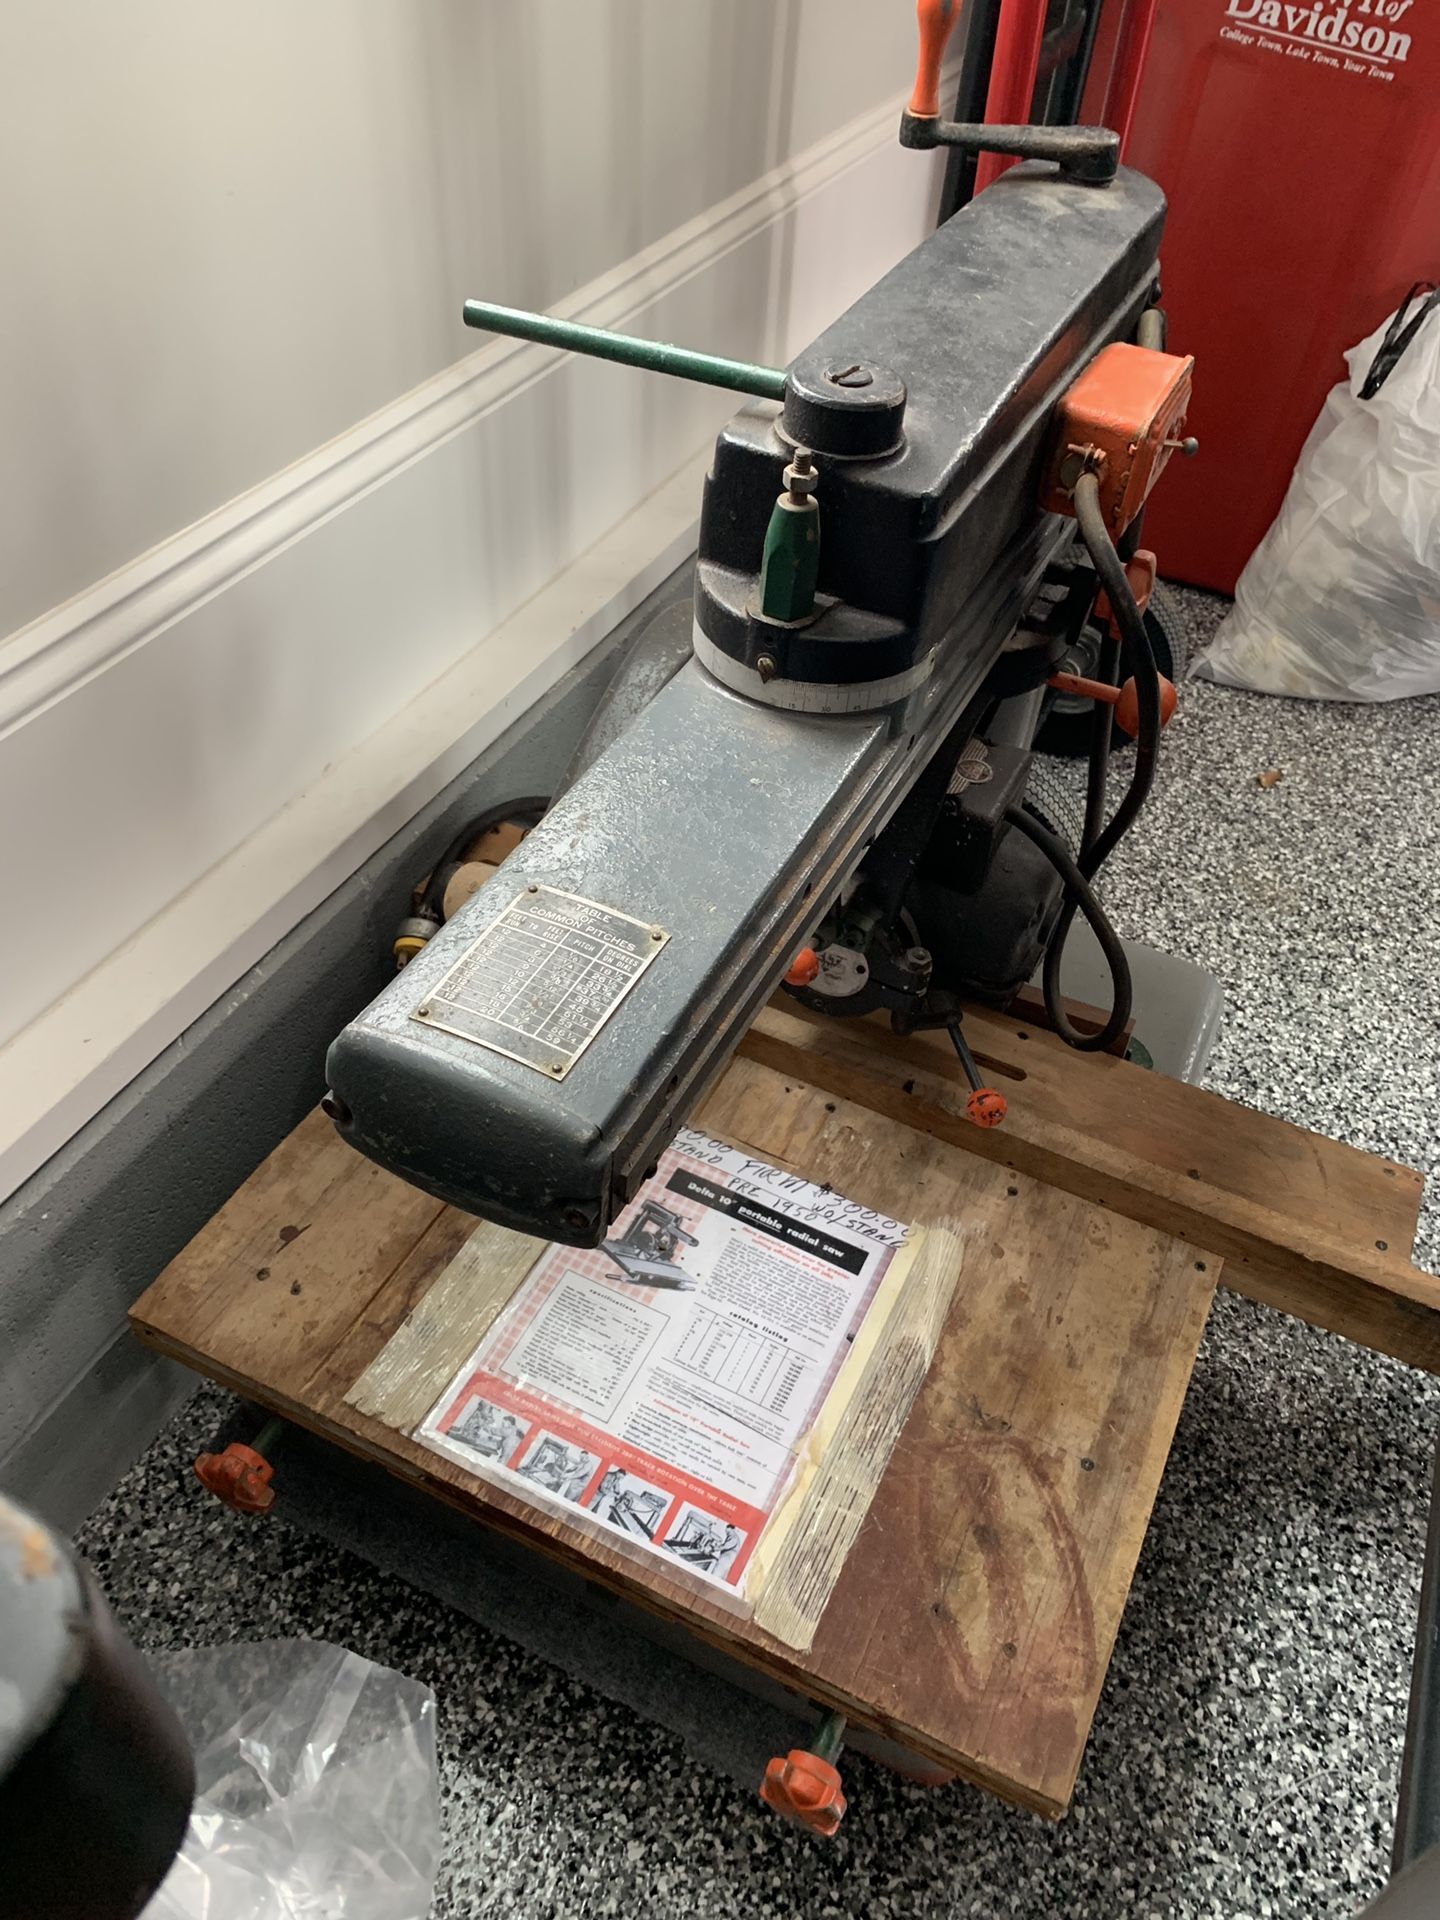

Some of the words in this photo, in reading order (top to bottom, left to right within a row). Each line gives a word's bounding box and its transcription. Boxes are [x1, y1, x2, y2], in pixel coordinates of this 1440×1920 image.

[1225, 0, 1412, 61] Davidson
[1219, 26, 1255, 45] College
[1286, 44, 1310, 60] Lake
[1343, 58, 1367, 74] Your
[1368, 65, 1395, 82] Town
[529, 906, 583, 929] COMMON
[585, 925, 637, 952] PITCHES
[575, 903, 612, 924] TABLE
[580, 914, 597, 925] OF
[573, 939, 596, 952] PITCH
[607, 949, 639, 968] DEGREES
[603, 955, 615, 964] ON
[616, 961, 632, 972] DIAL
[737, 1159, 809, 1193] FIRM
[727, 1177, 760, 1198] PRE
[770, 1198, 819, 1222] 1950
[687, 1181, 715, 1200] Delta
[737, 1205, 783, 1231] portable
[786, 1225, 820, 1247] radial
[822, 1243, 845, 1258] saw
[589, 1288, 637, 1313] specifications
[729, 1311, 758, 1329] catalog
[762, 1326, 789, 1343] listing
